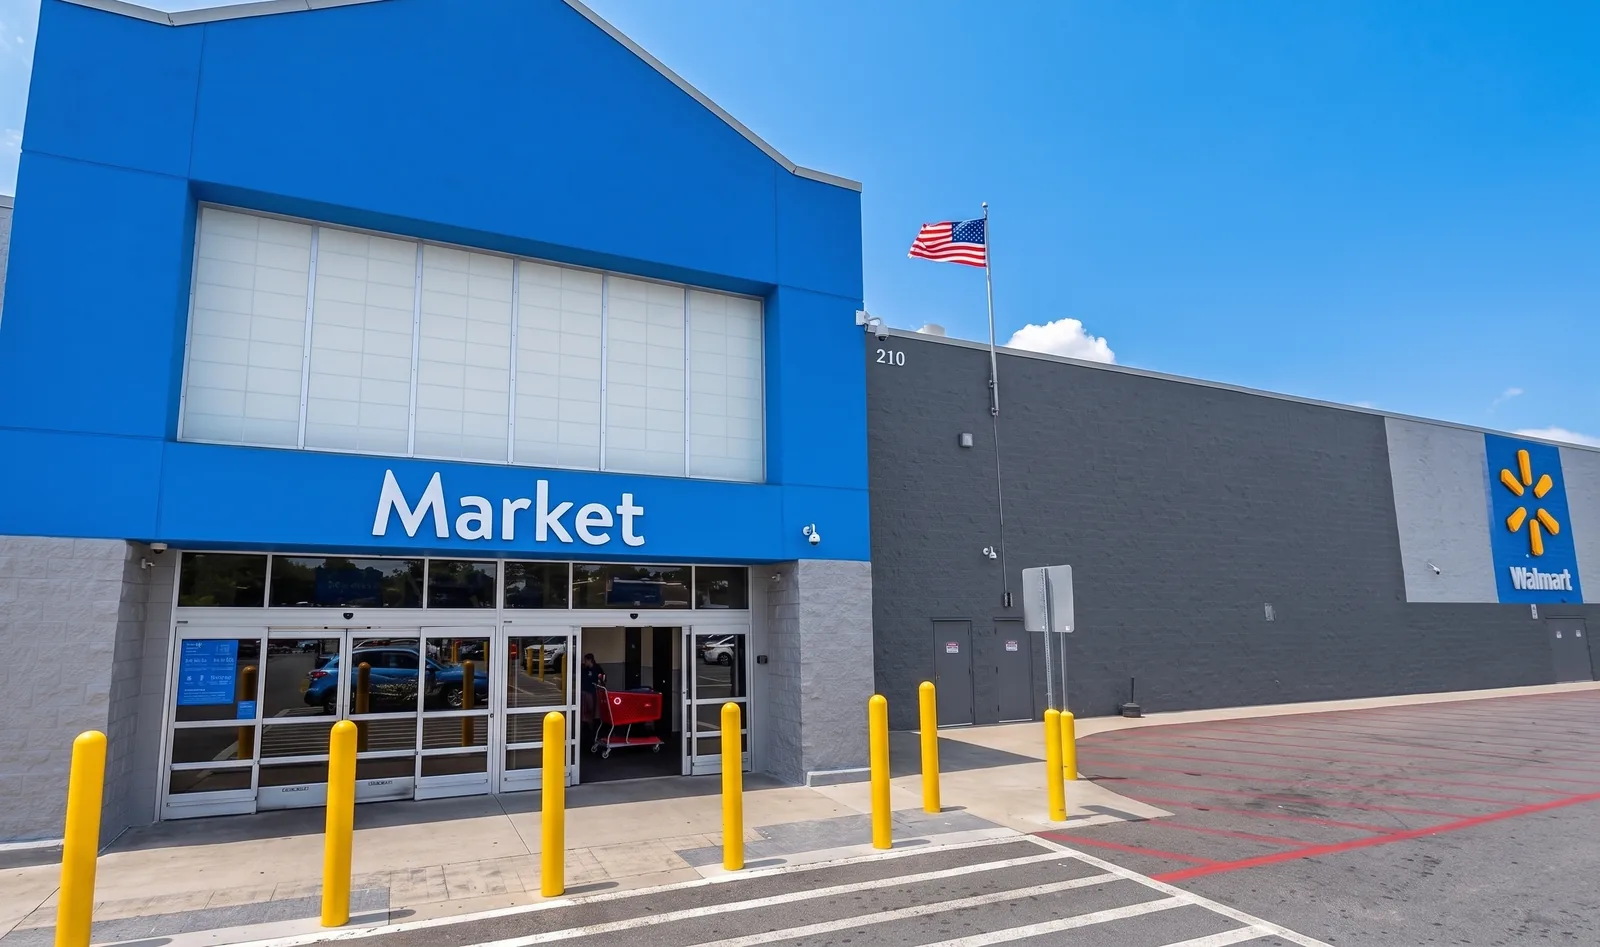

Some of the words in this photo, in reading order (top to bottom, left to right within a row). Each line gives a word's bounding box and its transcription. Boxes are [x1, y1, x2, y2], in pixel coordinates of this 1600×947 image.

[876, 348, 906, 367] 210
[371, 469, 645, 547] Market
[1509, 566, 1573, 591] Walmart
